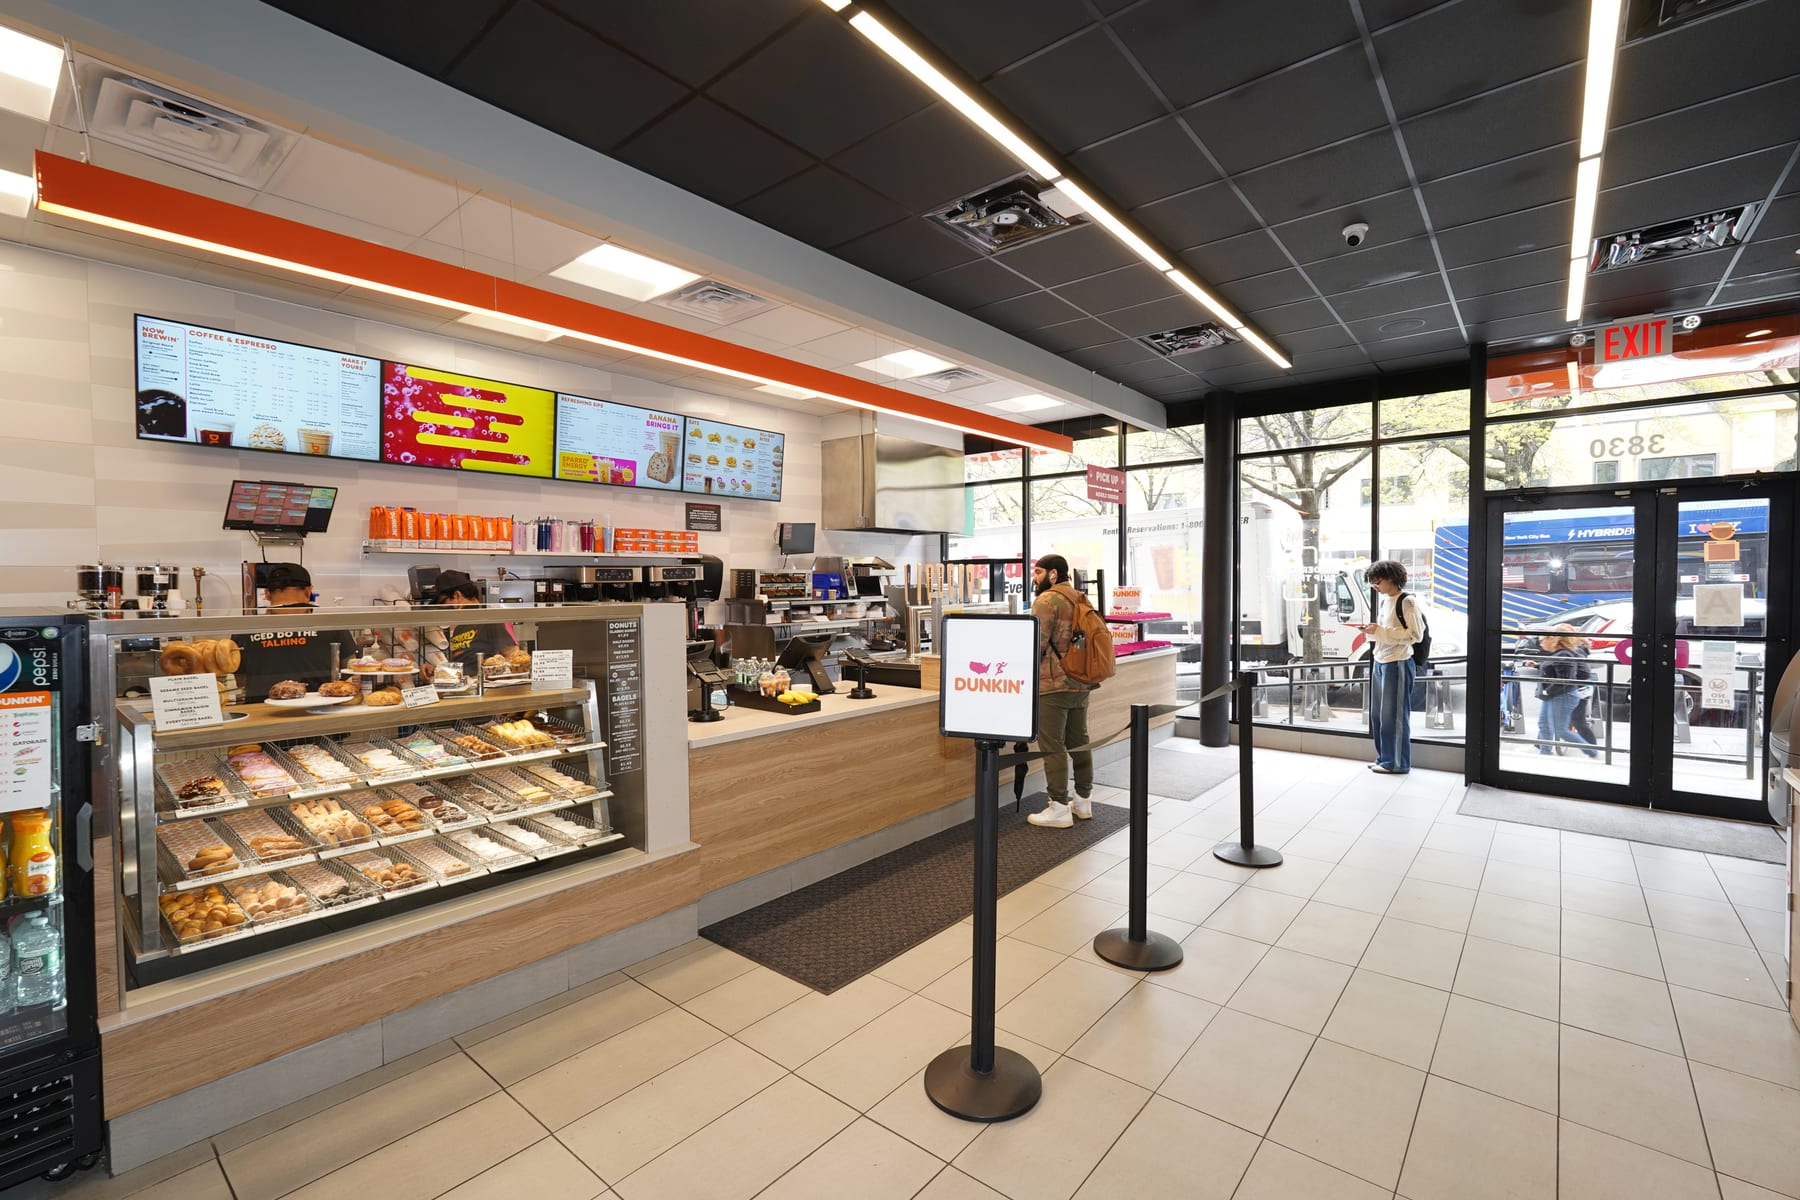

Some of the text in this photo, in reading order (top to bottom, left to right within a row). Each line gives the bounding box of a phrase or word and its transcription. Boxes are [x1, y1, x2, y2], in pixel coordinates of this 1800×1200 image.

[142, 326, 164, 334] NOW
[189, 330, 224, 341] COFFEE
[235, 338, 277, 350] ESPRESSO
[1604, 319, 1667, 361] EXIT
[341, 363, 363, 371] YOURS
[648, 413, 677, 424] BANANA
[646, 420, 679, 431] BRINGS IT
[1096, 471, 1119, 485] PICK UP
[1127, 523, 1179, 534] Reservations:
[1688, 523, 1697, 533] I
[609, 621, 637, 629] DONUTS
[250, 632, 274, 642] ICED
[261, 637, 307, 648] TALKING
[29, 646, 51, 686] pepsi
[954, 677, 1024, 694] DUNKIN'
[0, 695, 45, 706] UNKIN'
[612, 694, 637, 703] BAGELS
[12, 738, 48, 746] GATORADE
